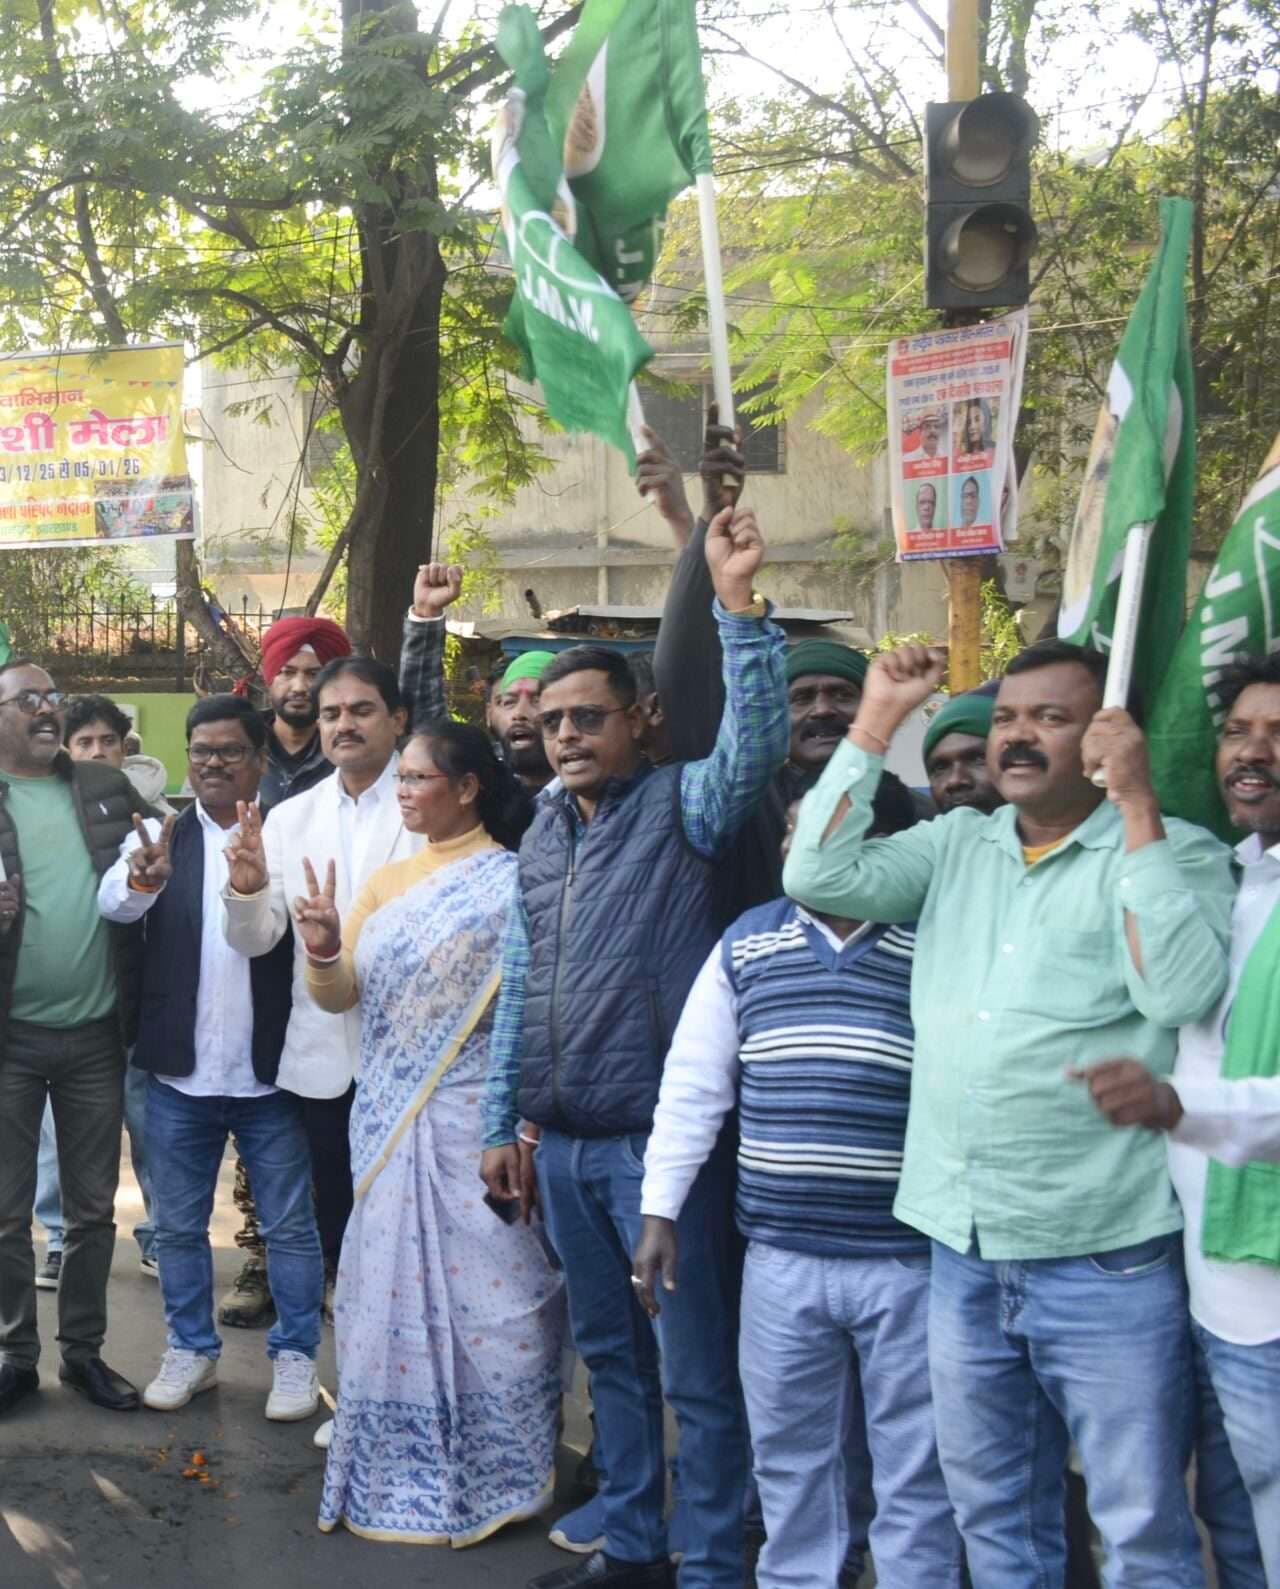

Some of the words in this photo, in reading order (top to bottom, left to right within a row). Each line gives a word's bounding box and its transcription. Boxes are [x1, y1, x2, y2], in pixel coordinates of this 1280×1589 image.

[70, 409, 170, 448] मेला
[60, 457, 70, 480] से
[74, 457, 140, 479] 05/01/26
